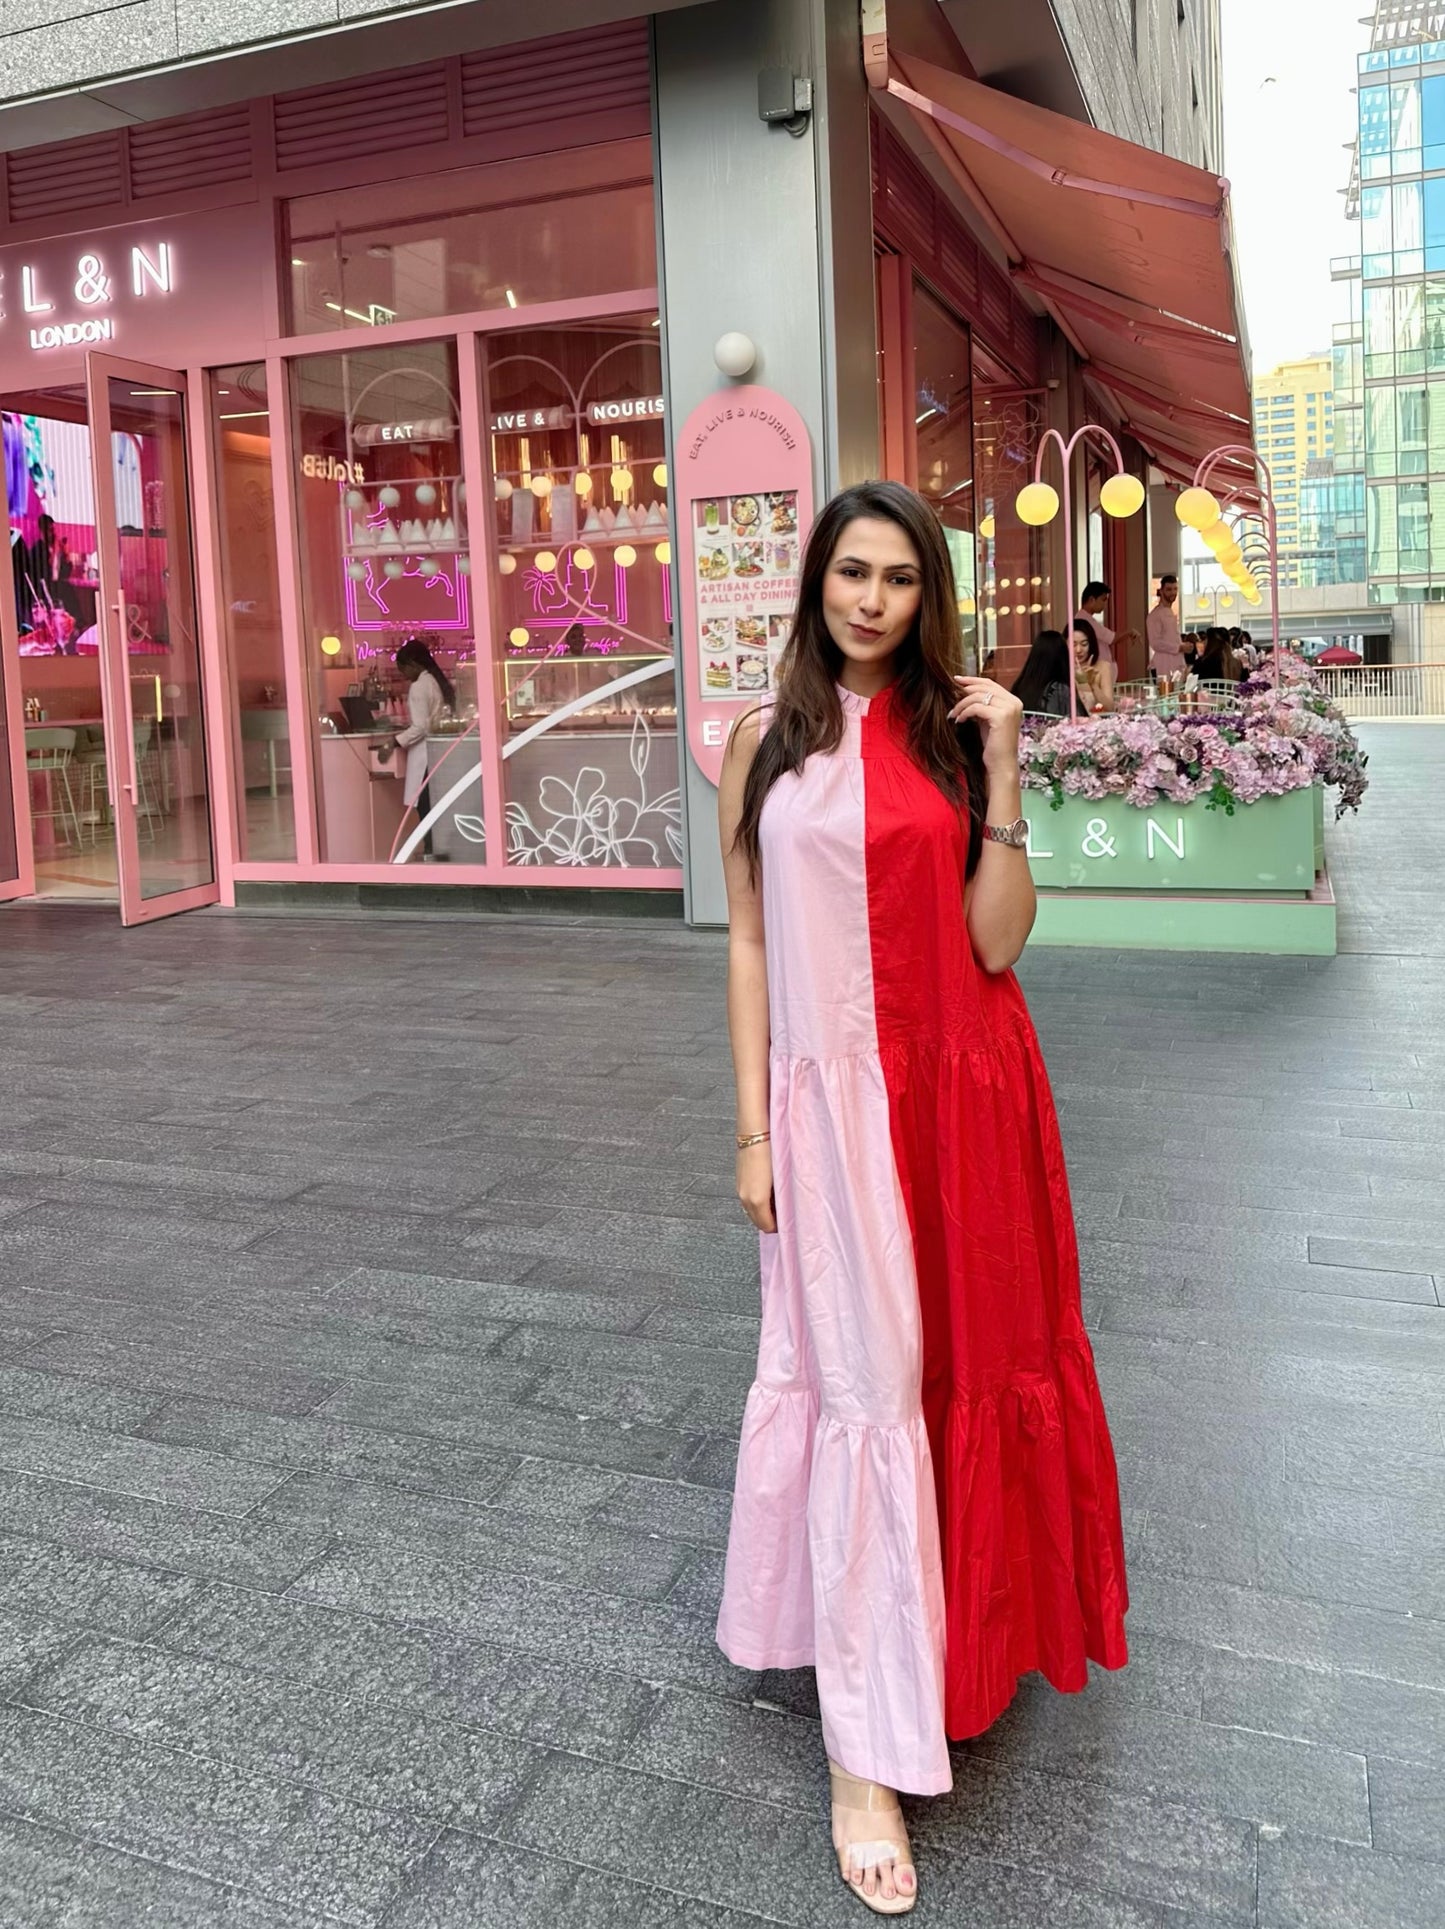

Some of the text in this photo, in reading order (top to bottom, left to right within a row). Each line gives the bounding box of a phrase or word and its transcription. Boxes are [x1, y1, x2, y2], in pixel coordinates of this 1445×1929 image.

[30, 318, 112, 349] LONDON
[593, 398, 665, 420] NOURIS
[534, 412, 545, 426] &
[381, 425, 413, 440] EAT
[706, 409, 734, 432] LIVE
[749, 408, 797, 450] NOURISH
[701, 577, 799, 593] ARTISAN COFFEE
[700, 595, 707, 604] &
[711, 594, 731, 603] ALL
[734, 592, 757, 602] DAY
